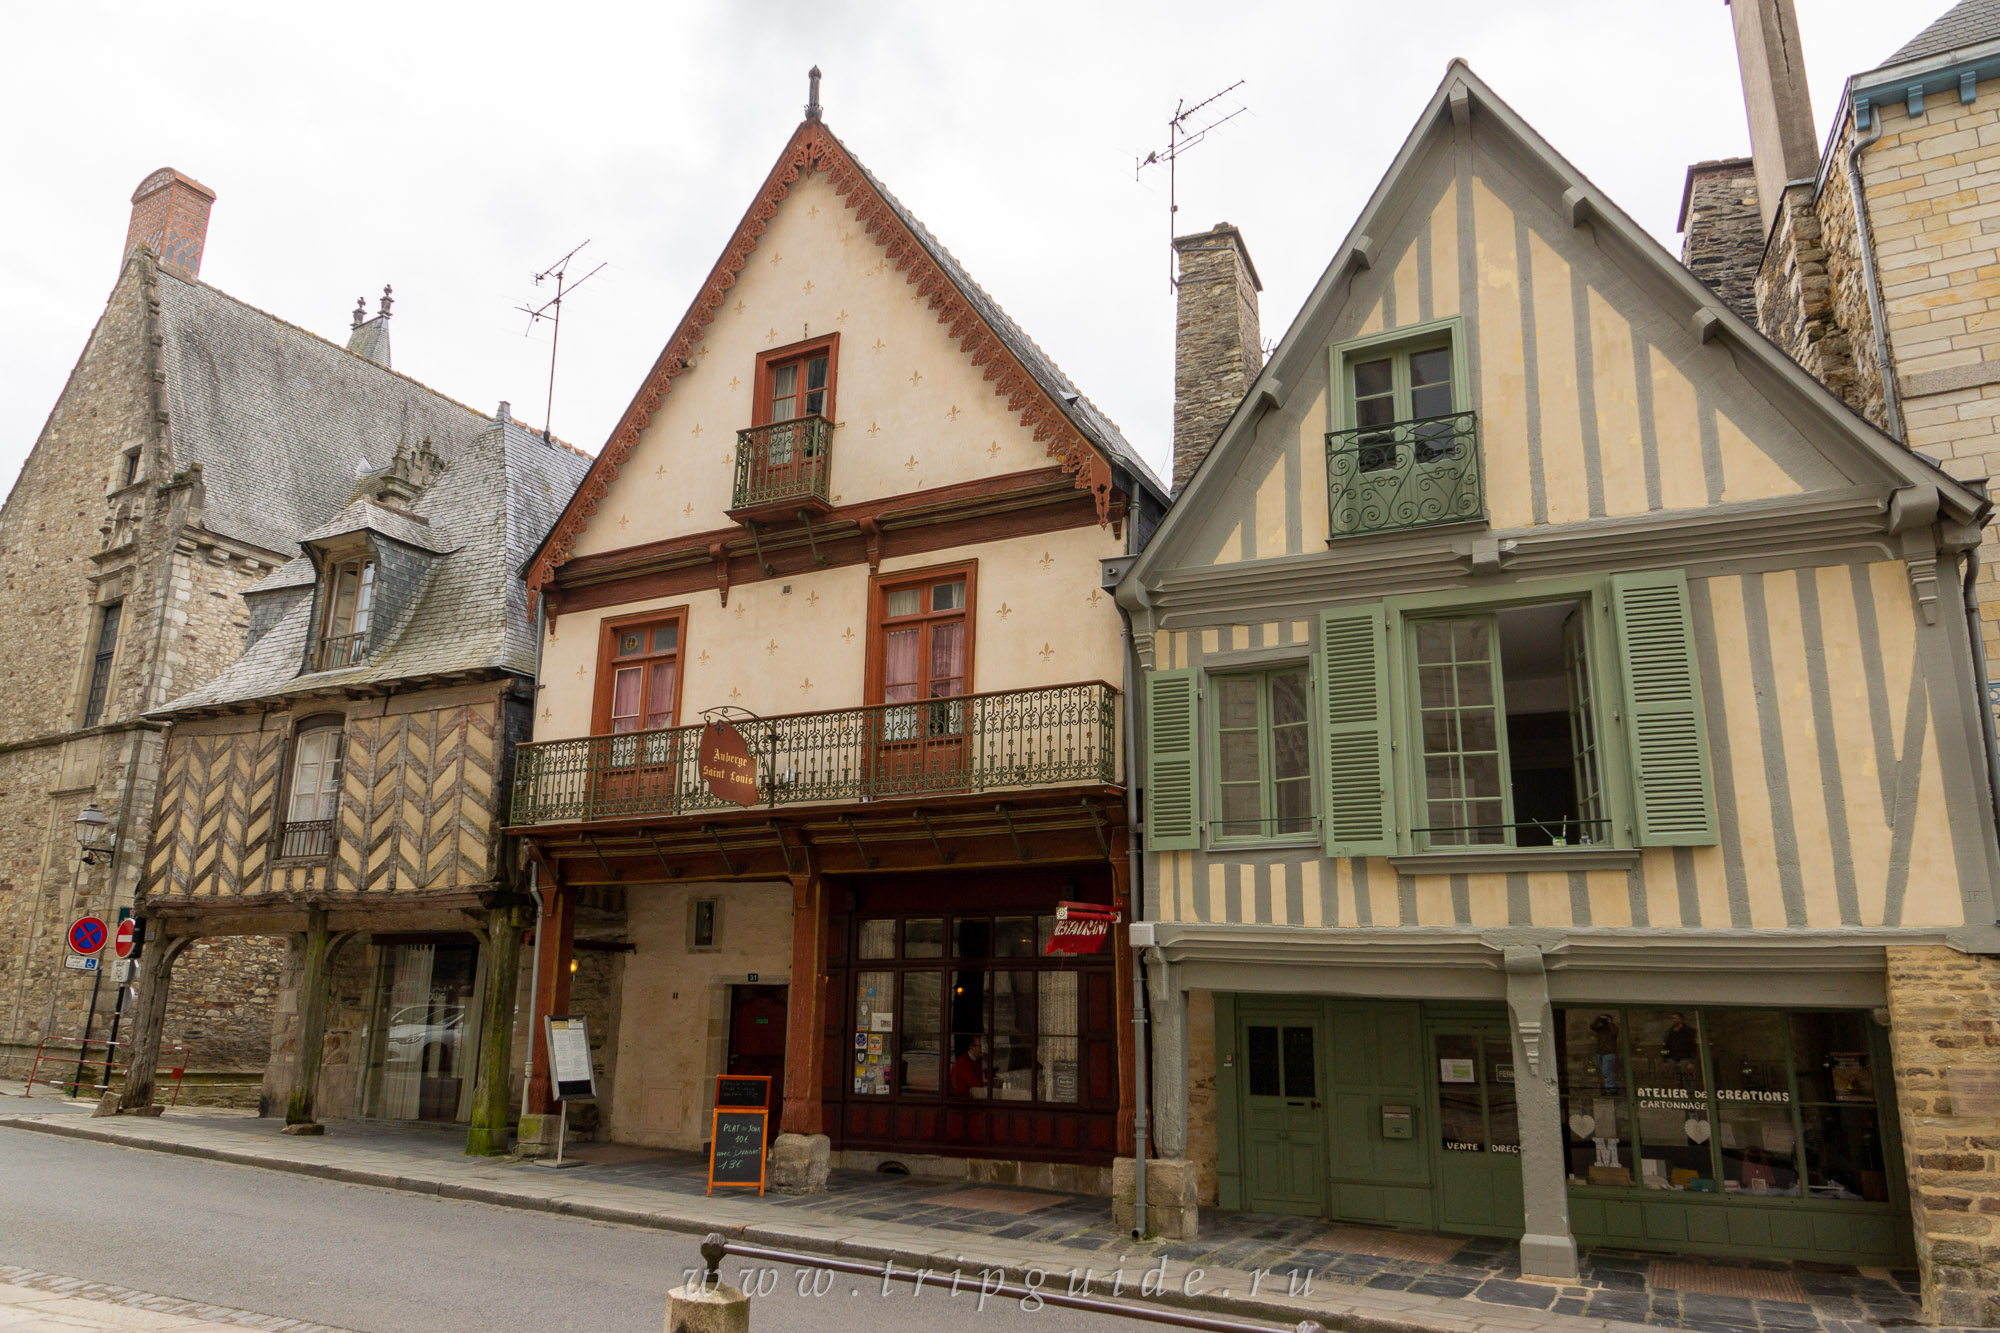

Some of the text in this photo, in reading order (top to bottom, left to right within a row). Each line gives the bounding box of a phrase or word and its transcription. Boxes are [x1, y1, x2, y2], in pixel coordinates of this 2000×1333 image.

[713, 748, 748, 768] Auberge
[703, 765, 754, 785] Saint Louis
[1637, 1087, 1790, 1102] ATELIER DE CREATIONS
[1640, 1100, 1707, 1111] CARTONNAGE
[723, 1123, 741, 1133] PLAT
[1446, 1142, 1479, 1151] VENTE
